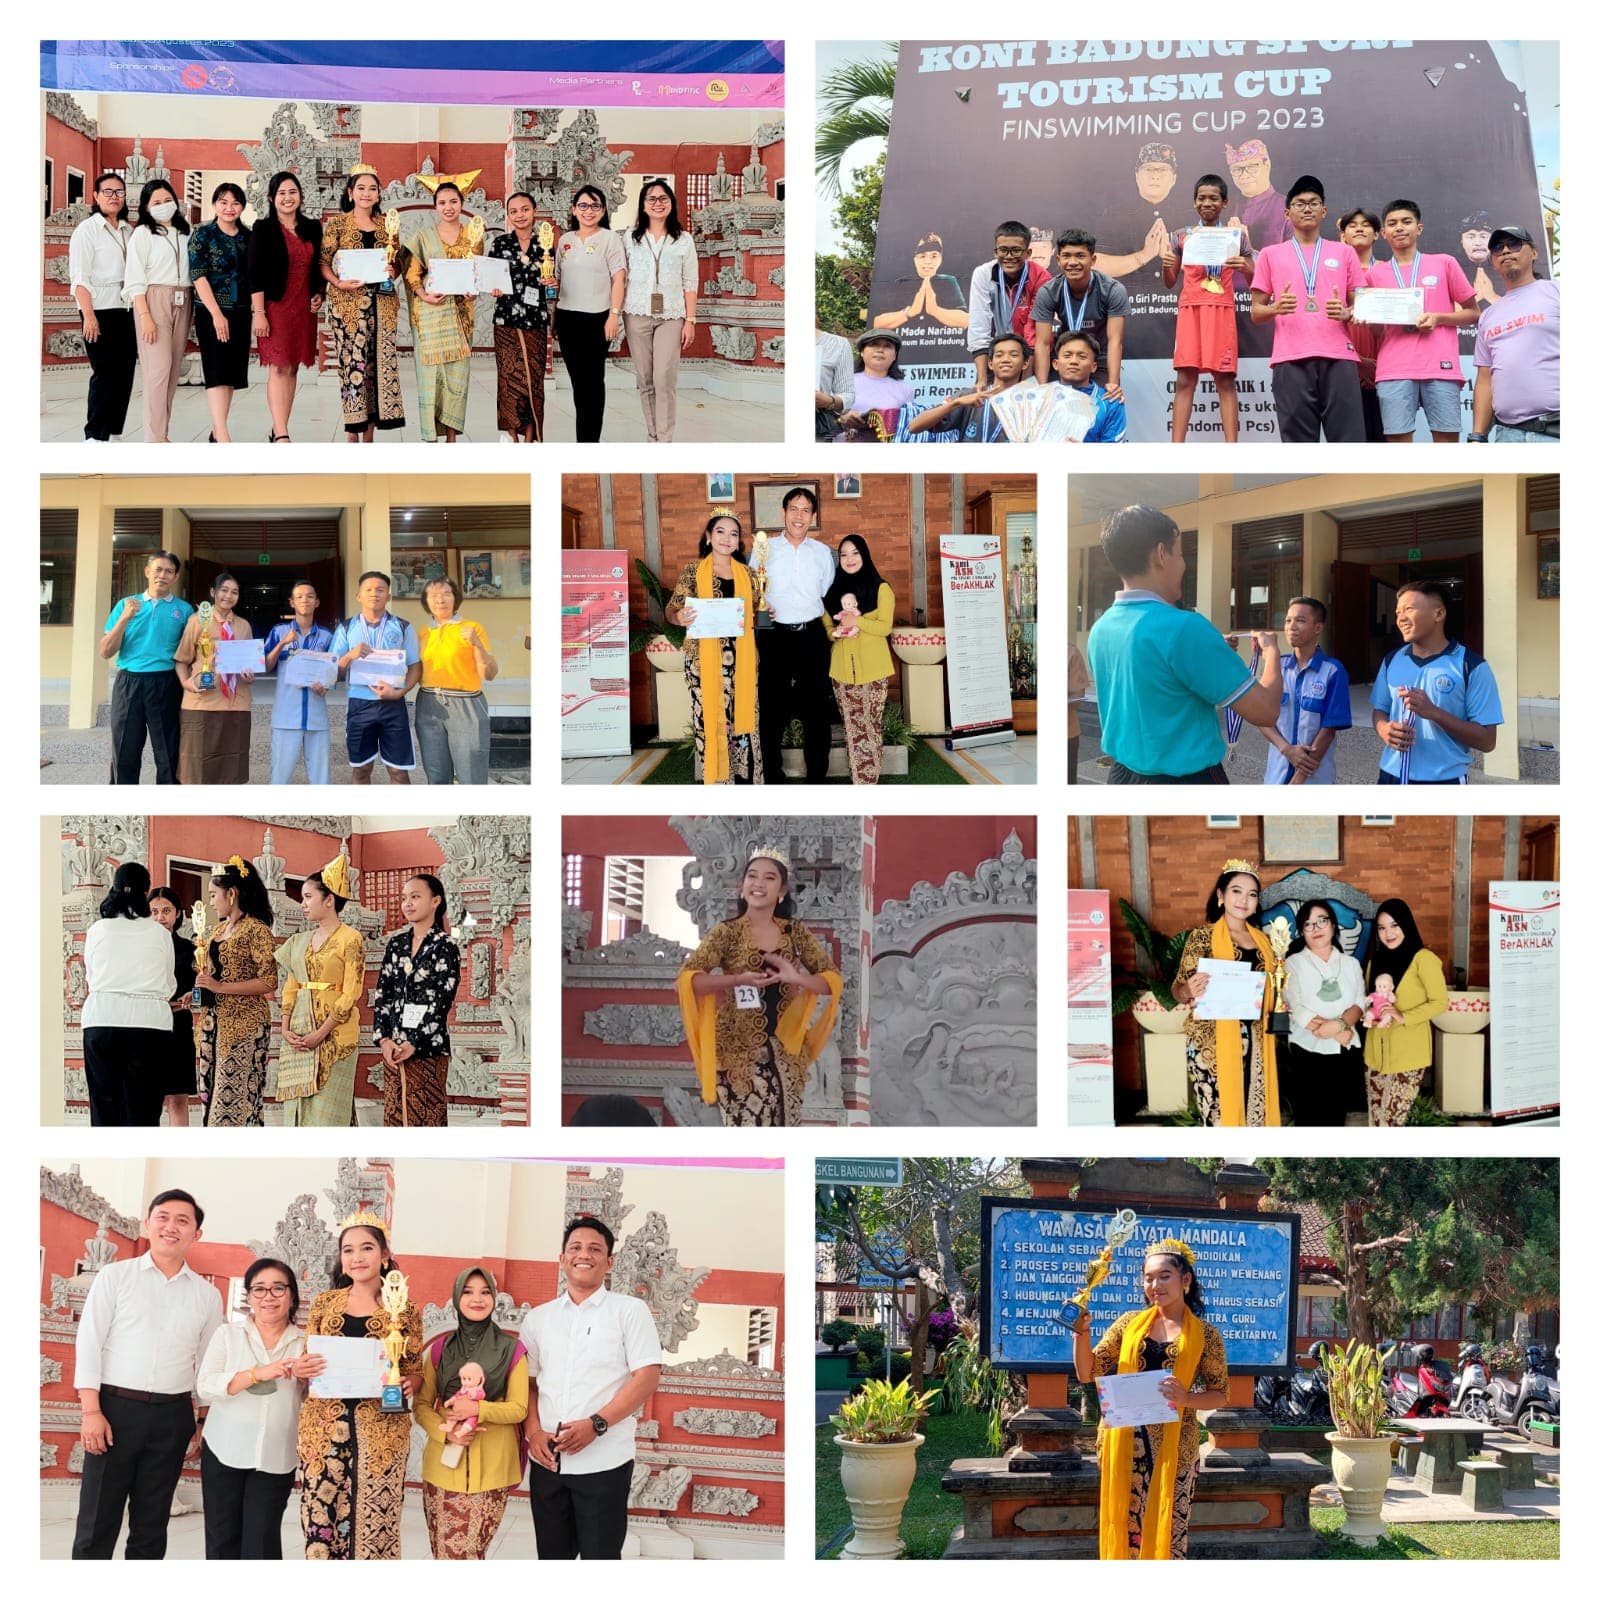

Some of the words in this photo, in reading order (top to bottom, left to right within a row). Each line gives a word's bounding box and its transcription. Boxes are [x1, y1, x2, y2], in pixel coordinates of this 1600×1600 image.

[918, 41, 1037, 73] KONI
[1046, 40, 1246, 65] BADUNG
[110, 62, 175, 71] Sponsorships
[549, 77, 578, 85] Media
[580, 77, 623, 85] Partners
[997, 72, 1223, 109] TOURISM
[1233, 67, 1332, 98] CUP
[1002, 112, 1183, 141] FINSWIMMING
[1192, 110, 1247, 133] CUP
[1256, 107, 1325, 130] 2023
[1135, 293, 1150, 304] Giri
[1151, 293, 1178, 303] Prasta
[1233, 291, 1252, 302] Ketu
[1131, 306, 1147, 316] pati
[1148, 305, 1179, 315] Badung
[1505, 313, 1545, 330] SWIM
[901, 325, 925, 337] Made
[927, 325, 963, 336] Nariana
[919, 337, 936, 346] Koni
[937, 337, 965, 347] Badung
[910, 367, 967, 381] SWIMMER
[1246, 420, 1275, 433] Pcs)
[951, 580, 995, 590] BerAKHLAK
[1500, 937, 1553, 950] BerAKHLAK
[738, 989, 755, 1002] 23
[815, 1164, 839, 1177] GKEL
[840, 1165, 885, 1178] BANGUNAN
[1133, 1225, 1174, 1242] IYATA
[1179, 1228, 1247, 1247] MANDALA
[1002, 1243, 1009, 1252] 1.
[1014, 1242, 1065, 1254] SEKOLAH
[1068, 1244, 1102, 1256] SEBAG
[1118, 1246, 1147, 1257] LINGK
[1196, 1251, 1244, 1262] ENDIDIKAN.
[1001, 1259, 1011, 1270] 2.
[1015, 1260, 1058, 1271] PROSES
[1062, 1262, 1122, 1273] PENDAN
[1127, 1264, 1136, 1274] DI
[1196, 1267, 1228, 1279] DALAH
[1231, 1269, 1281, 1281] WEWENANG
[1015, 1272, 1036, 1283] DAN
[1040, 1273, 1088, 1285] TANGGUN
[1102, 1275, 1129, 1286] AWAB
[1002, 1290, 1012, 1301] 3.
[1015, 1290, 1068, 1301] HUBUNGAN
[1103, 1292, 1122, 1303] DAN
[1127, 1293, 1145, 1303] ORA
[1213, 1296, 1242, 1306] HARUS
[1001, 1307, 1012, 1318] 4.
[1016, 1308, 1060, 1319] MENJUN
[1203, 1313, 1228, 1323] ITRA
[1231, 1314, 1256, 1323] GURU
[1001, 1325, 1012, 1335] 5.
[1015, 1325, 1066, 1337] SEKOLAH
